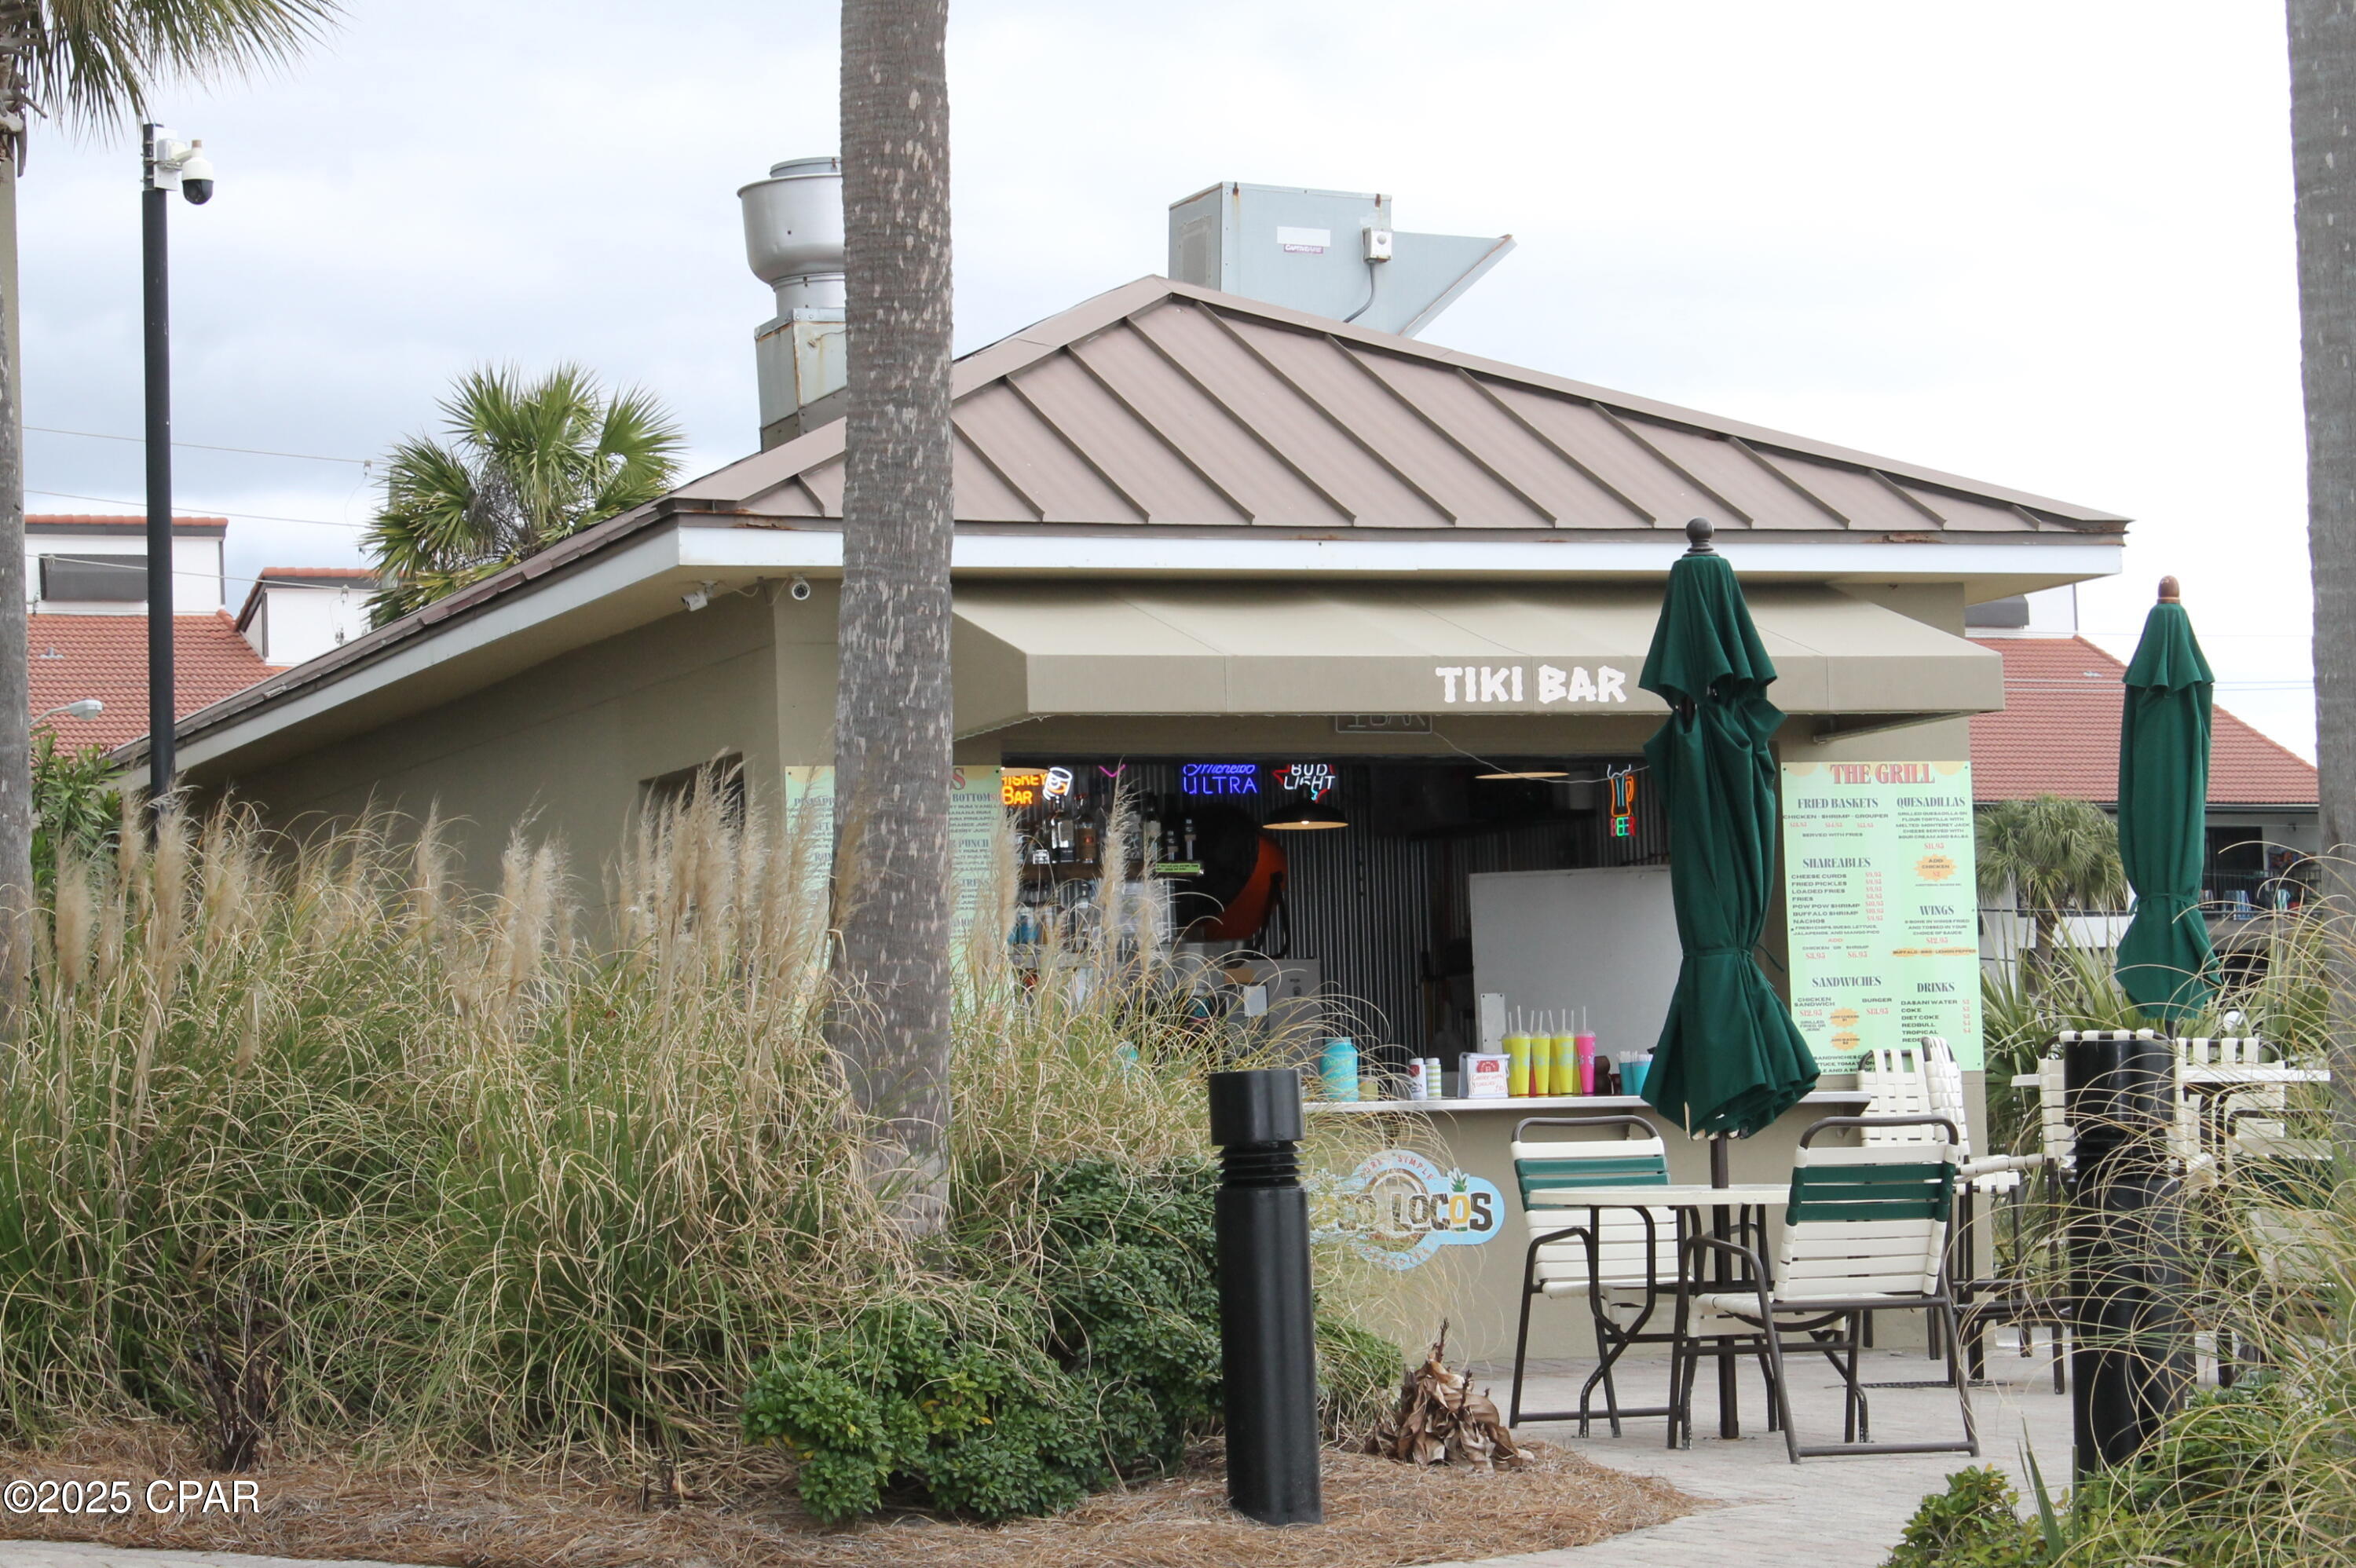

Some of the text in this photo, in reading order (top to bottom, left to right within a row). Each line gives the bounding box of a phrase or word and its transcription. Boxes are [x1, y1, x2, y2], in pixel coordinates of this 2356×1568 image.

[1436, 664, 1626, 704] TIKI BAR
[1291, 764, 1327, 776] BUD
[1830, 763, 1935, 784] THE GRILL
[1001, 773, 1047, 785] HISKEY
[1284, 776, 1335, 790] LIGHT
[1183, 777, 1257, 795] ULTRA
[1798, 798, 1879, 808] FRIED BASKETS
[1897, 797, 1966, 809] QUESADILLAS
[1611, 817, 1636, 837] BEER
[1803, 857, 1871, 868] SHAREABLES
[1919, 905, 1954, 916] WINGS
[1812, 976, 1882, 987] SANDWICHES
[1917, 982, 1955, 992] DRINKS
